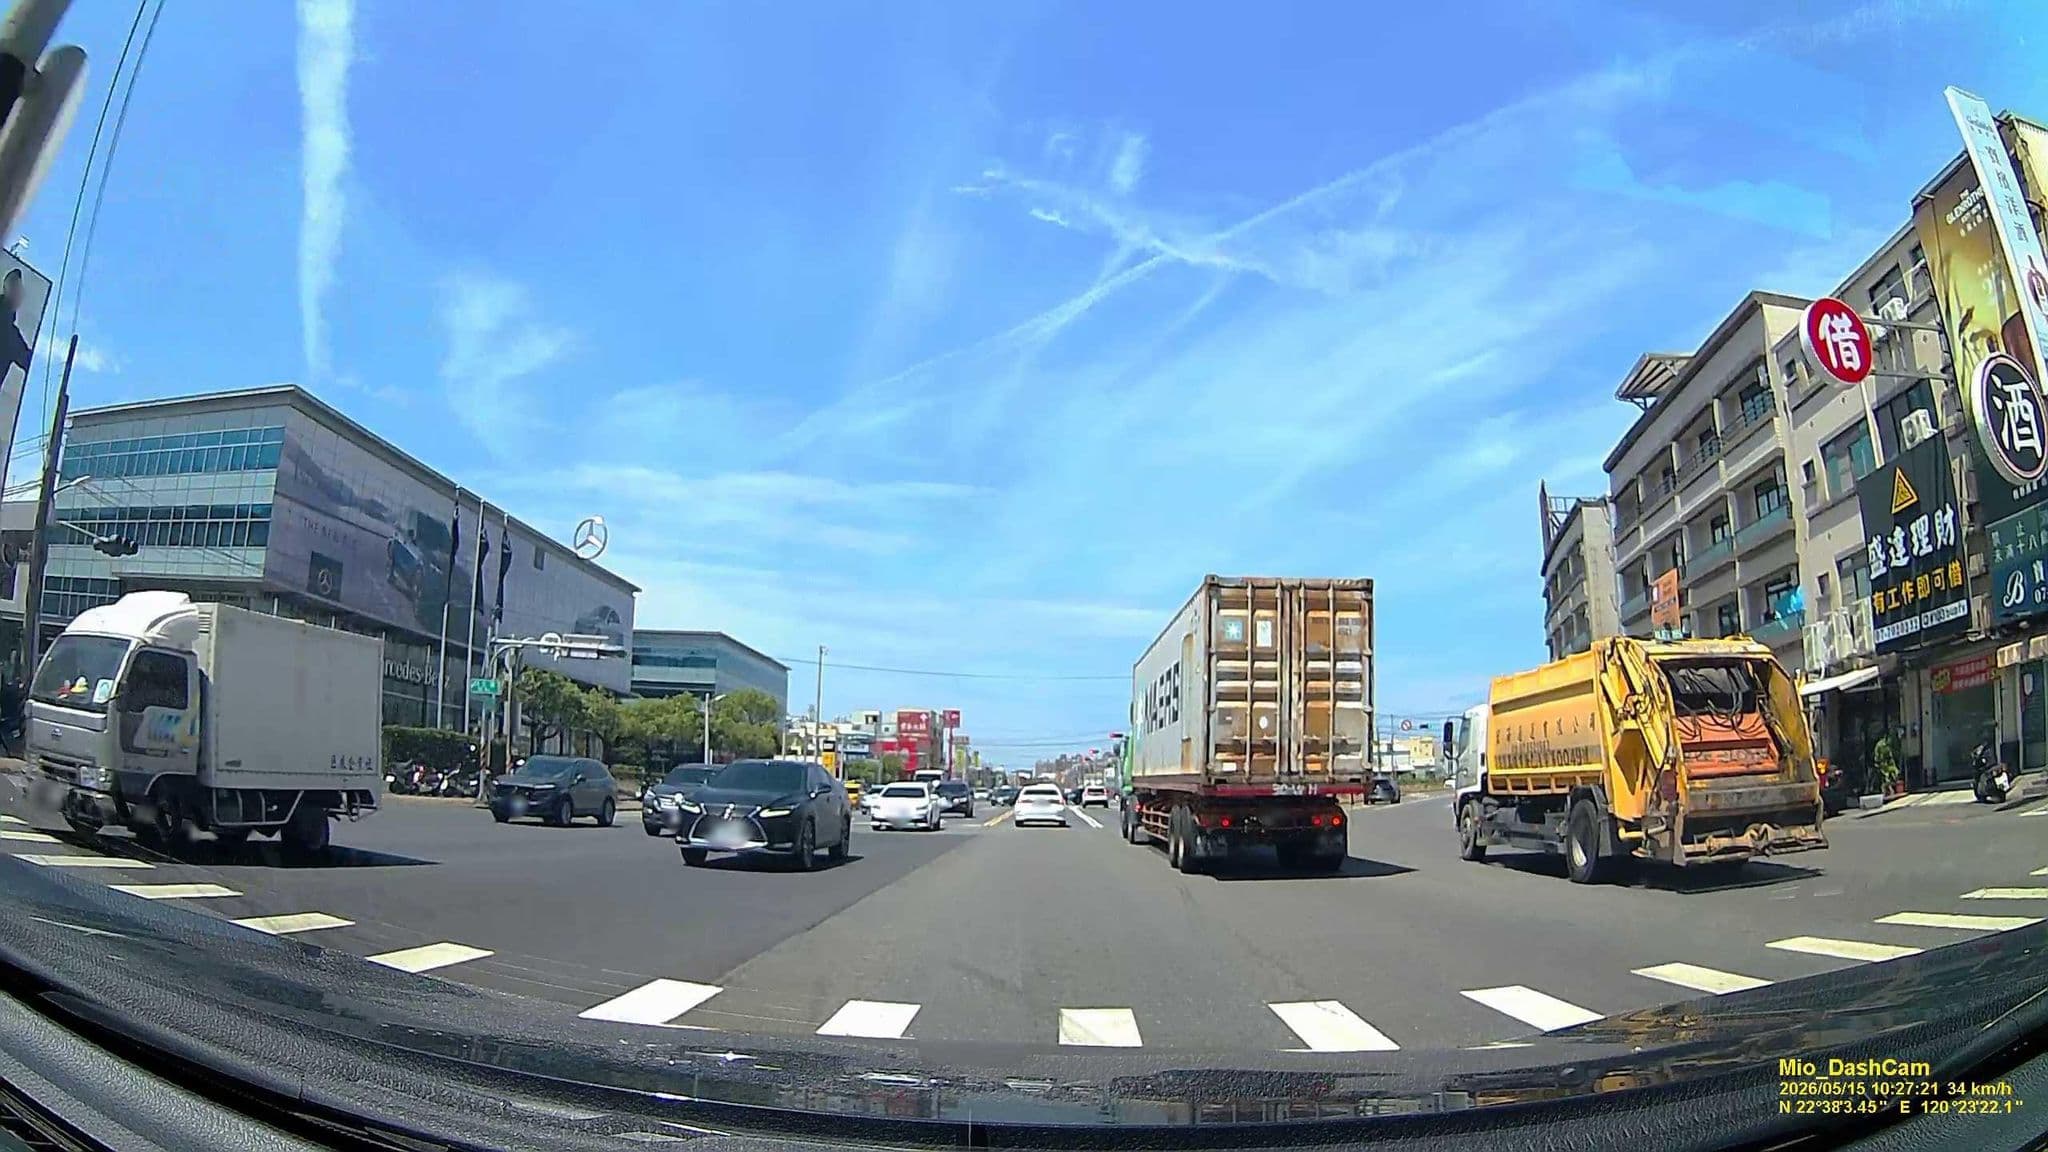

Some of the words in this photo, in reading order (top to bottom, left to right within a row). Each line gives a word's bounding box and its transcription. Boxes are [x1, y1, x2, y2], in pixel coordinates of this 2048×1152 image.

[1819, 312, 1861, 370] 借
[1991, 373, 2043, 458] 酒
[1867, 502, 1955, 580] 盛達理財
[1873, 559, 1963, 615] 有工作即可借
